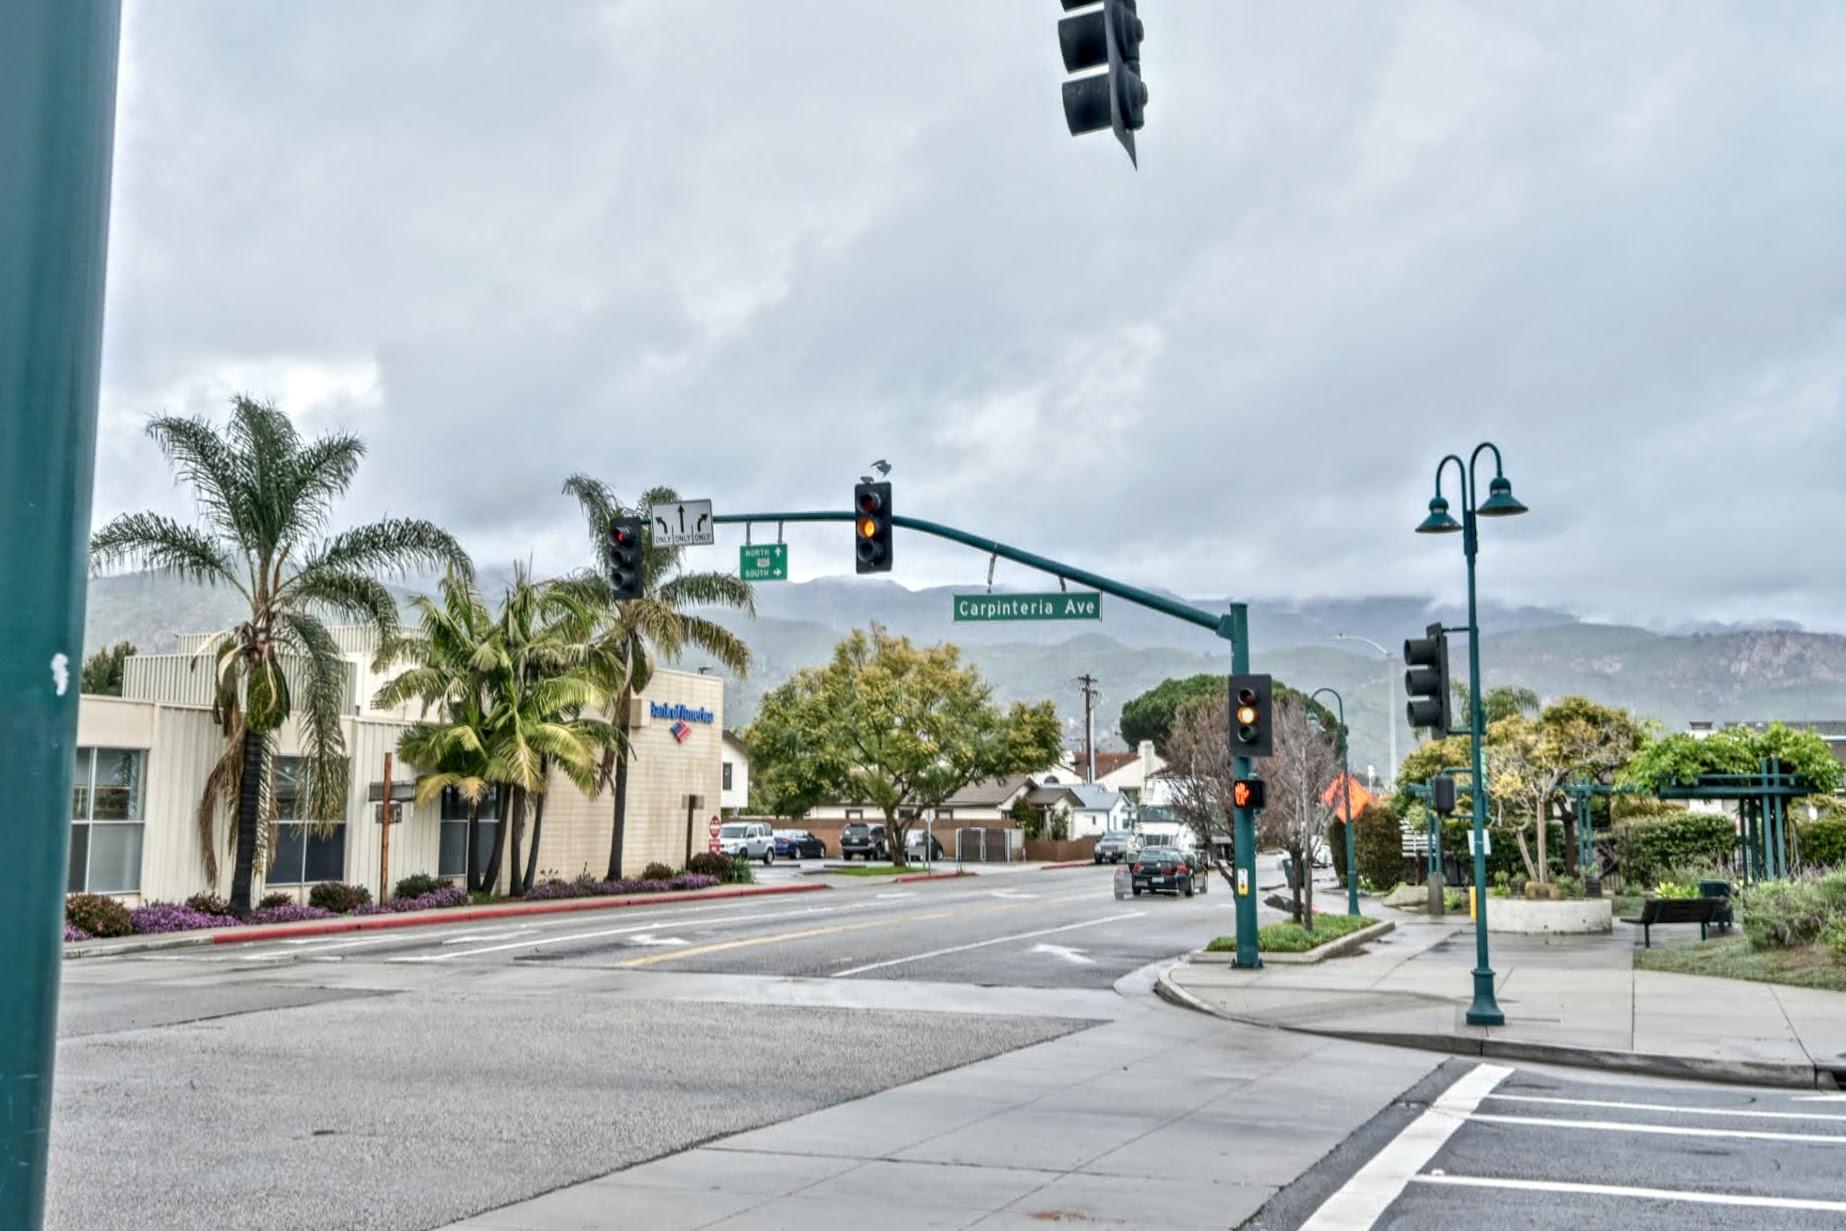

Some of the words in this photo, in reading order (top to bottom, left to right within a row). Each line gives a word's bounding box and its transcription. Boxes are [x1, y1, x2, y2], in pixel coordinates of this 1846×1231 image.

[655, 535, 671, 543] ONLY
[674, 534, 691, 543] ONLY
[694, 533, 711, 542] ONLY
[745, 548, 769, 557] NORTH
[745, 569, 769, 578] SOUTH
[959, 599, 1054, 618] Carpinteria
[1064, 598, 1095, 615] Ave
